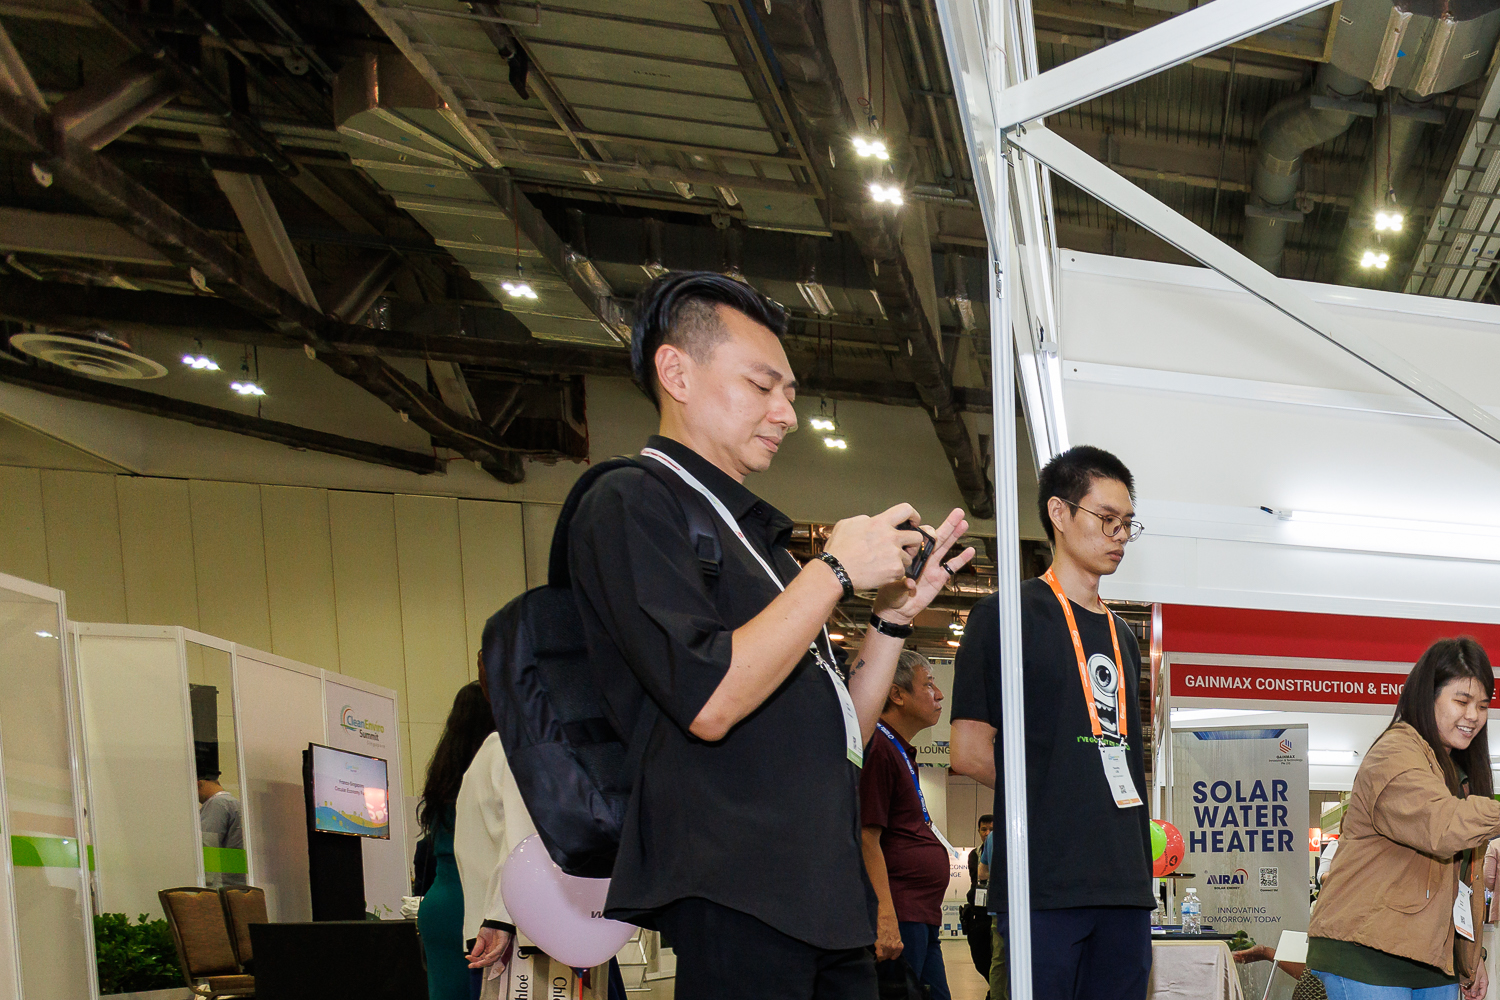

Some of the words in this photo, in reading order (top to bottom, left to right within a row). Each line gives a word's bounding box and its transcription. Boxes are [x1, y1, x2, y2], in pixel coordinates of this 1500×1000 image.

[1185, 674, 1252, 690] GAINMAX
[1255, 677, 1364, 694] CONSTRUCTION
[1367, 683, 1377, 695] &
[360, 730, 379, 741] Summit
[920, 746, 950, 754] LOUNG
[1193, 780, 1288, 803] SOLAR
[1193, 805, 1288, 828] WATER
[1189, 830, 1294, 853] HEATER
